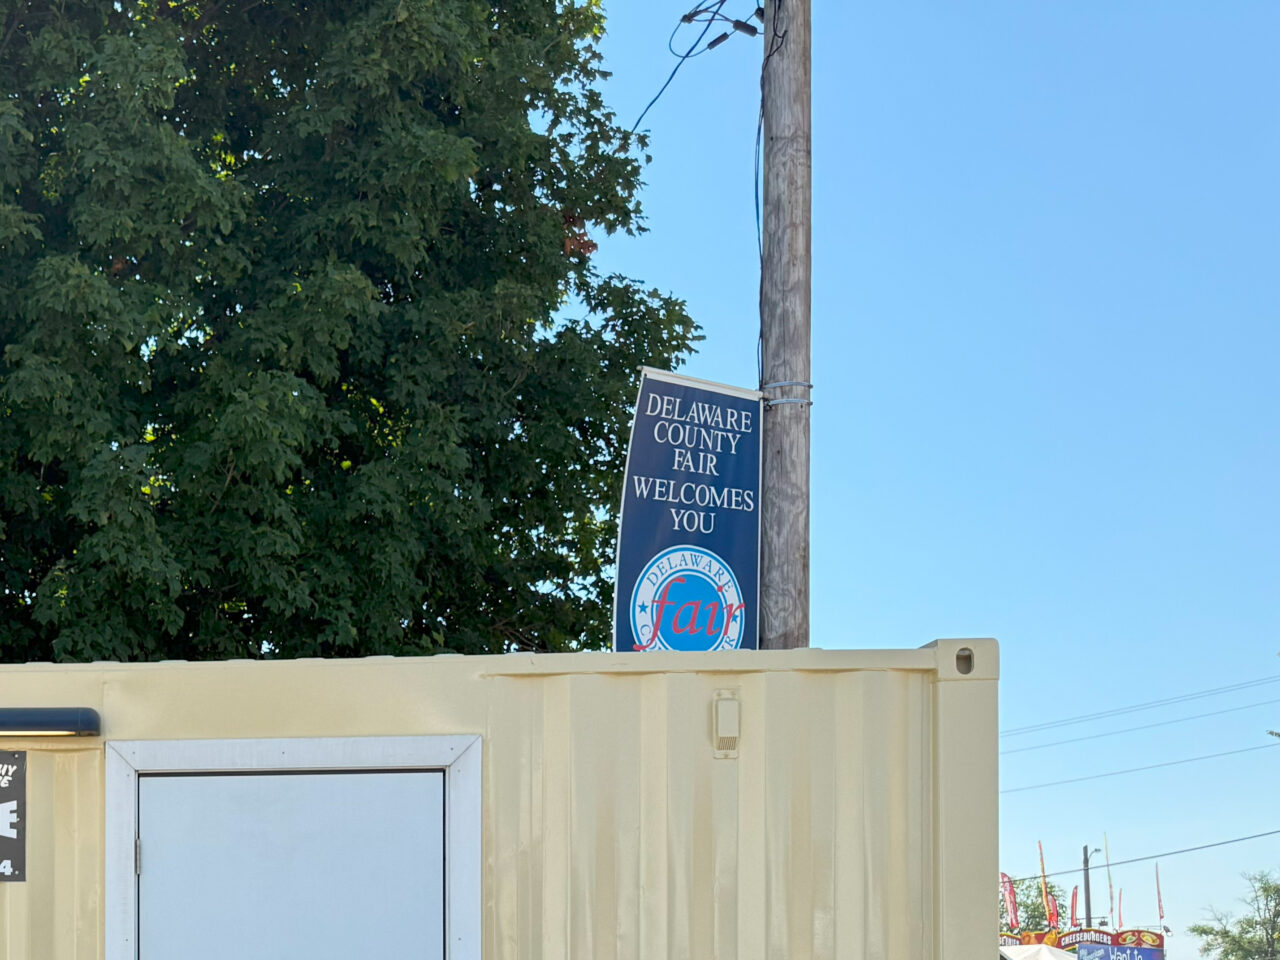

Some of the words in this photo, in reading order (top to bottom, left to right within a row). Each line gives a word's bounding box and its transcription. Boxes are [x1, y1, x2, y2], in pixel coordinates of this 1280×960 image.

[645, 392, 752, 433] DELAWARE
[653, 420, 741, 455] COUNTY
[671, 449, 720, 476] FAIR
[633, 476, 754, 512] WELCOMES
[670, 508, 716, 534] YOU
[647, 553, 733, 592] DELAWARE
[633, 577, 745, 651] fair
[1061, 931, 1111, 945] CHEESEBURGERS
